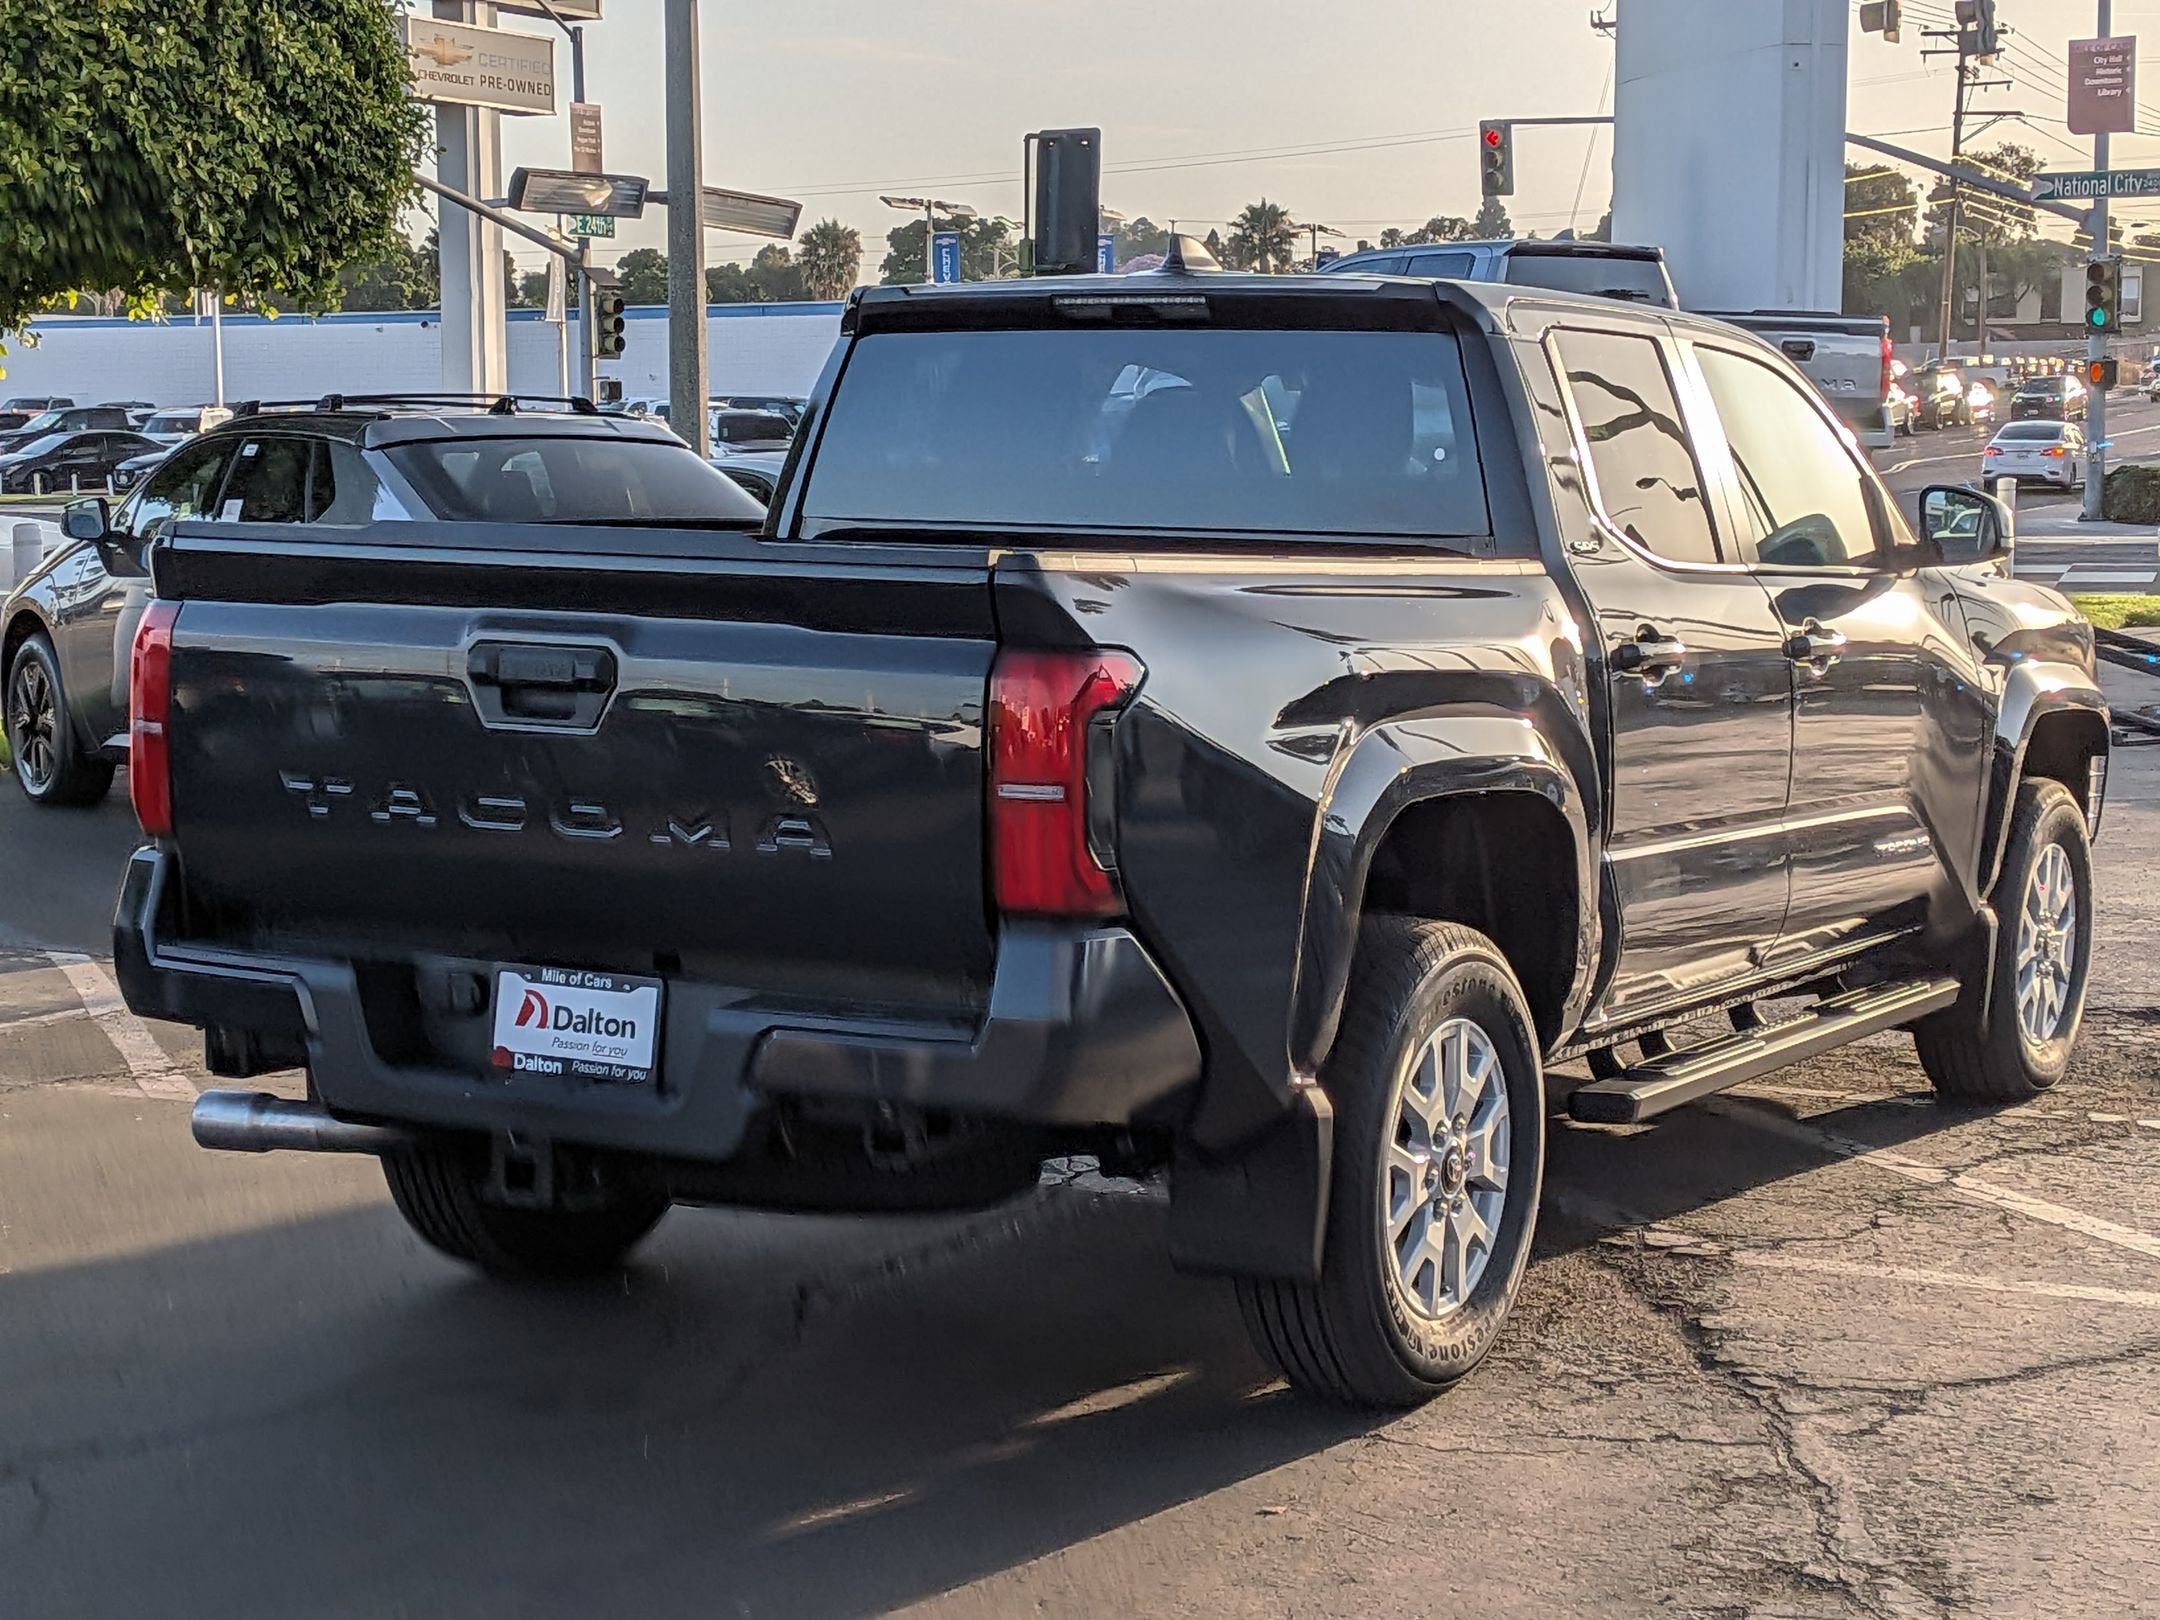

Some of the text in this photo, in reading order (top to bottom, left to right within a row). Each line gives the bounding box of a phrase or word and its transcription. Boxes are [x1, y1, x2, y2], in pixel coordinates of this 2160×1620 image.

[417, 69, 551, 96] CHEVROLET PRE-OWNED
[2097, 88, 2122, 97] Library
[2053, 172, 2143, 196] National City
[577, 215, 585, 234] E
[586, 215, 607, 235] 24th
[279, 769, 833, 859] TACOMA
[541, 968, 612, 988] Mile of Cars
[553, 1004, 636, 1039] Dalton
[552, 1036, 628, 1057] Passion for you
[513, 1054, 563, 1074] Dalton
[571, 1060, 648, 1081] Passion for you
